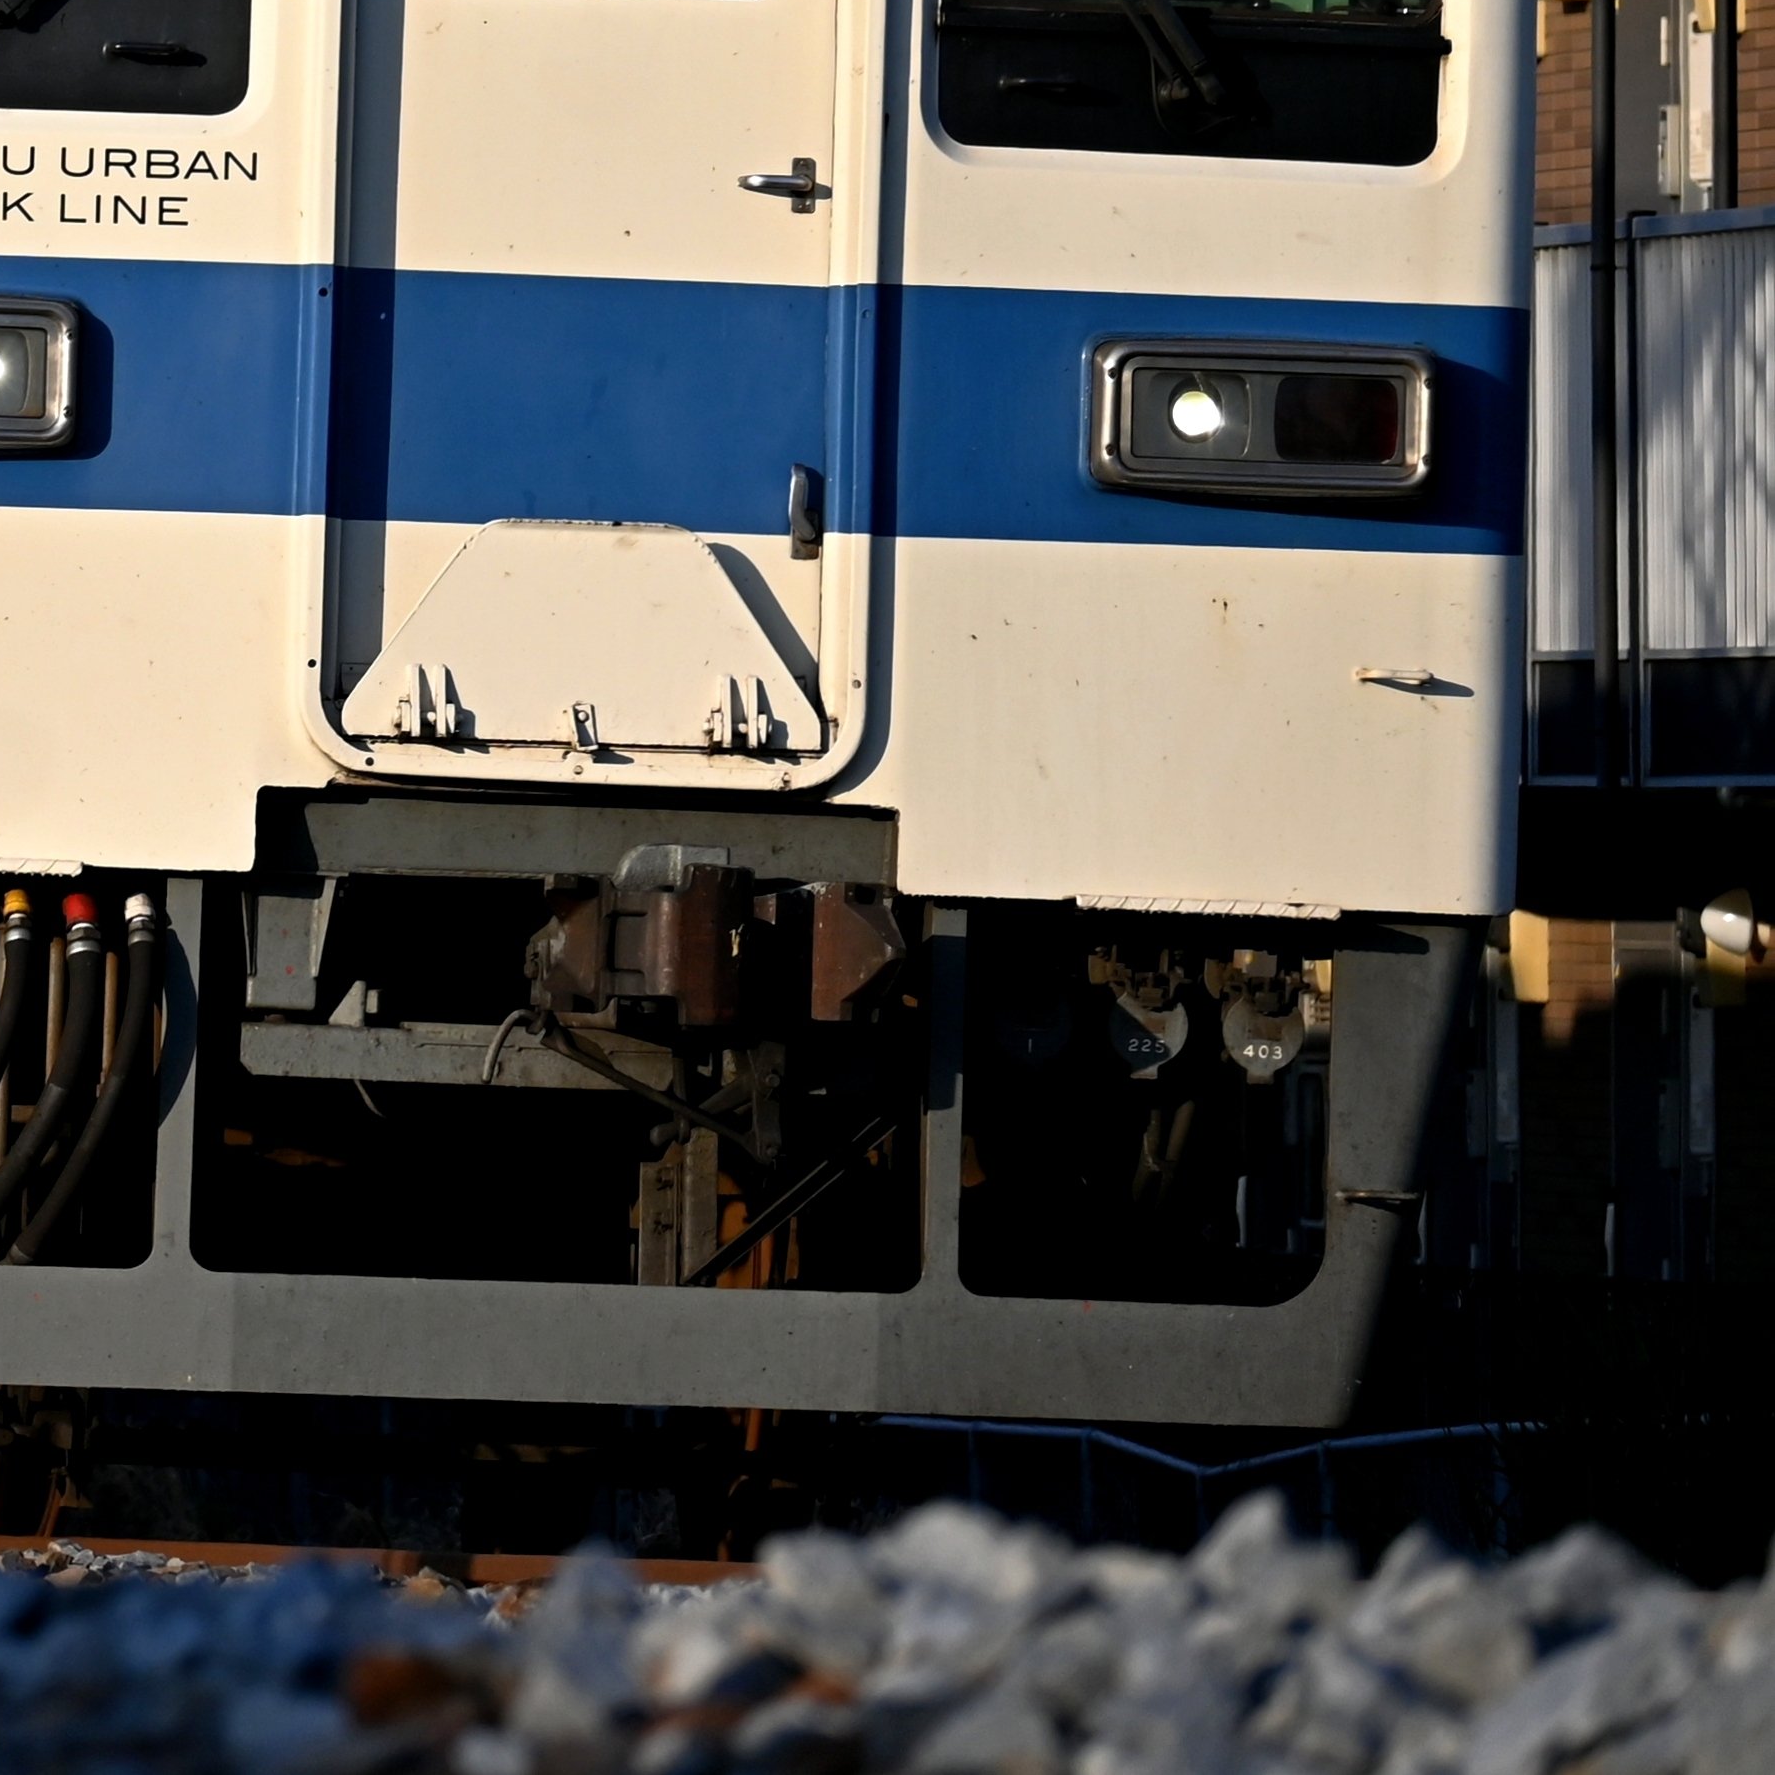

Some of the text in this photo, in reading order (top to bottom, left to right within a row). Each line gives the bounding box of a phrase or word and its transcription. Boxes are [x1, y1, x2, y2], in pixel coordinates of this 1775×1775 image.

[60, 146, 259, 181] URBAN
[59, 193, 191, 226] LINE
[1127, 1037, 1166, 1054] 225
[1242, 1043, 1283, 1060] 403
